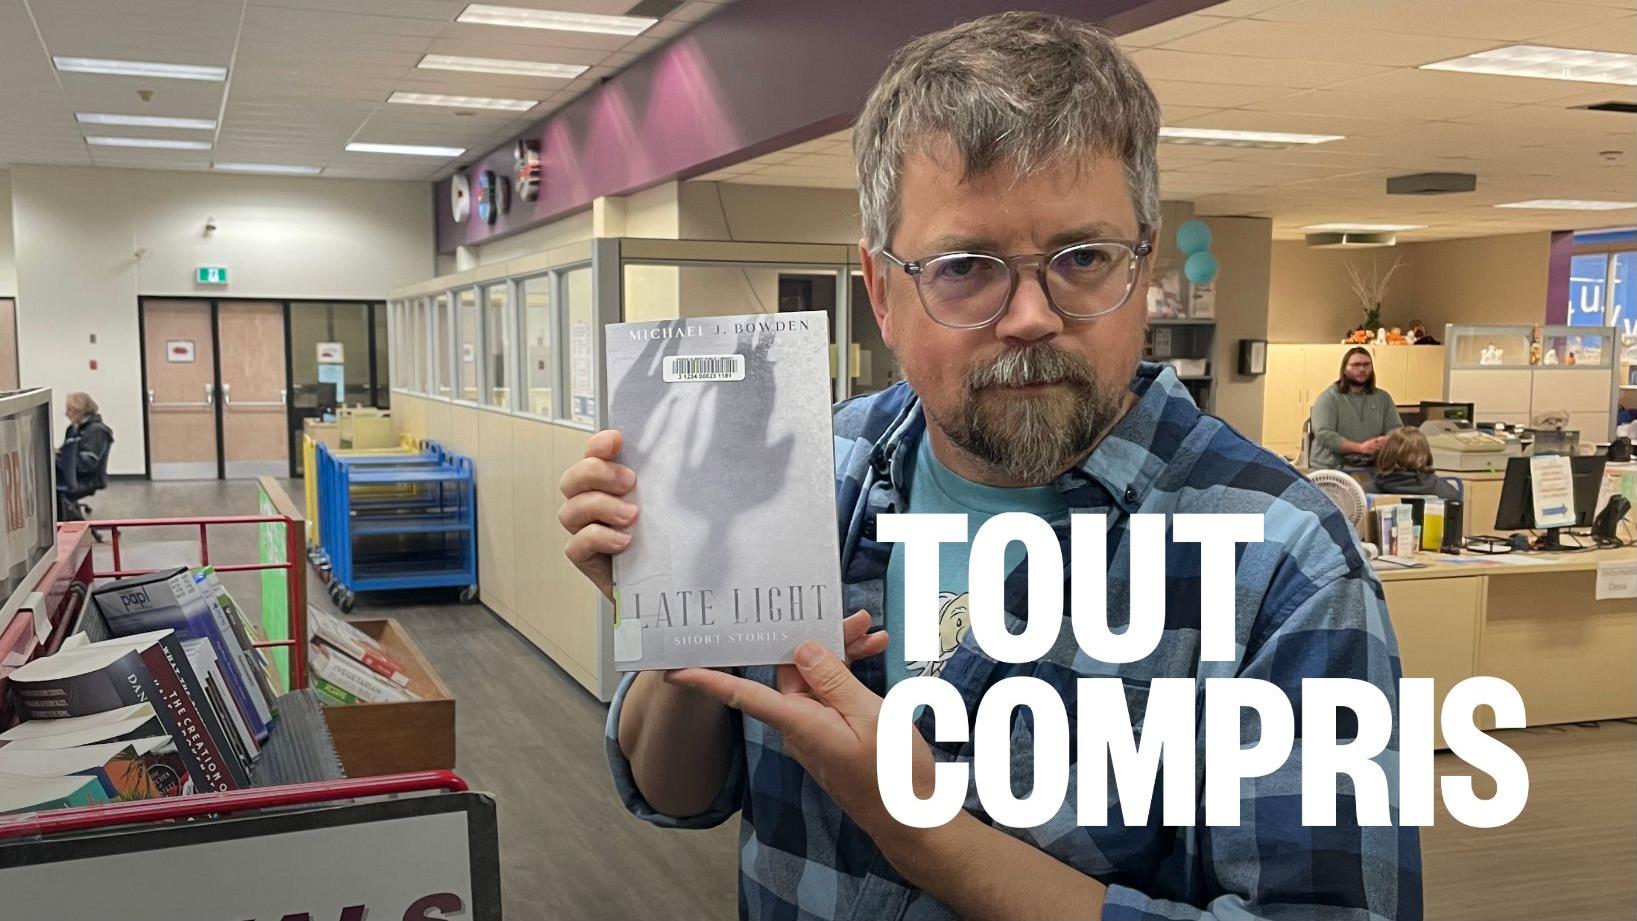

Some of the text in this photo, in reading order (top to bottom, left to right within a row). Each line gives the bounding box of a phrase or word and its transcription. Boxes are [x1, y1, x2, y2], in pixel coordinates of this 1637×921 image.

[630, 320, 809, 340] MICHAEL J. BOWDEN
[631, 584, 827, 629] LATE LIGHT
[673, 631, 789, 646] SHORT STORIES
[169, 690, 187, 716] THE
[182, 717, 223, 781] CREATION
